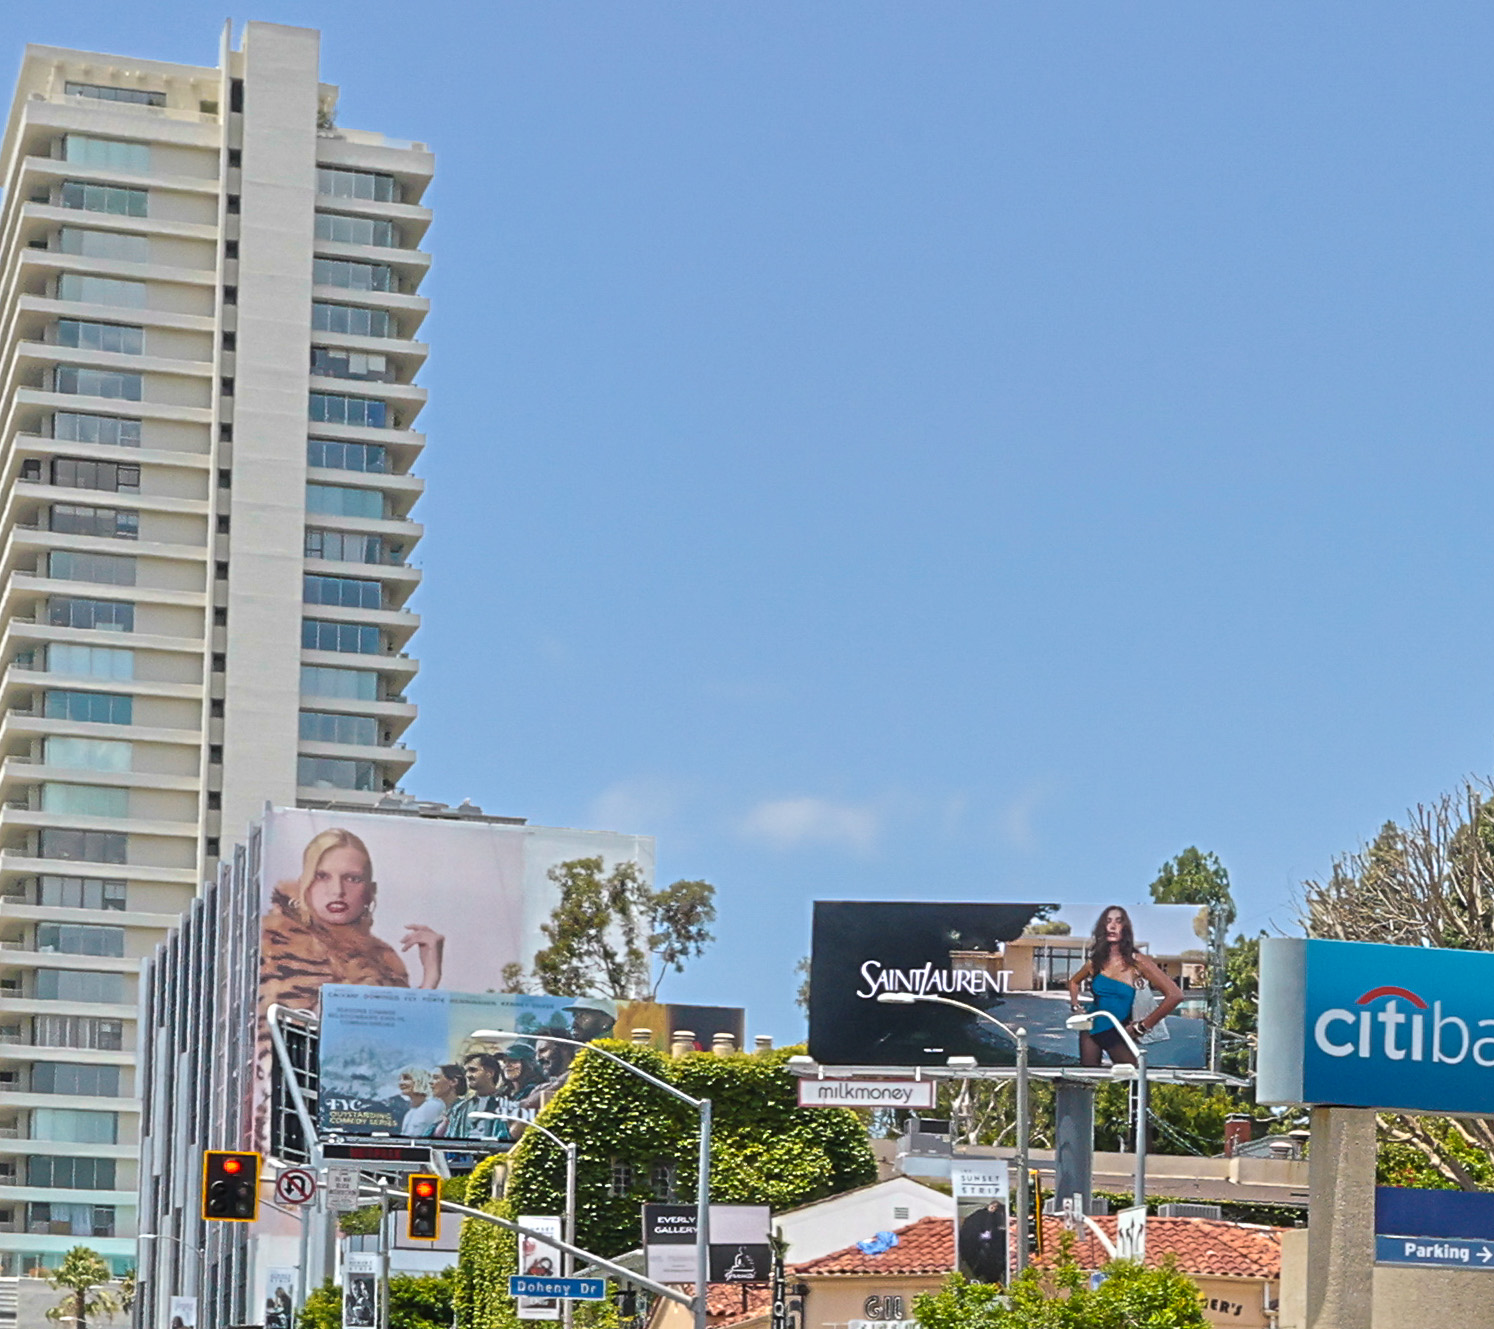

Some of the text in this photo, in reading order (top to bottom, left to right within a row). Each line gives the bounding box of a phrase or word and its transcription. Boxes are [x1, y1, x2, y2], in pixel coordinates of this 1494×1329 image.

[818, 1082, 913, 1103] milkmoney
[654, 1226, 698, 1234] GALLERY
[1405, 1241, 1470, 1263] Parking
[517, 1280, 597, 1296] Doheny Dr
